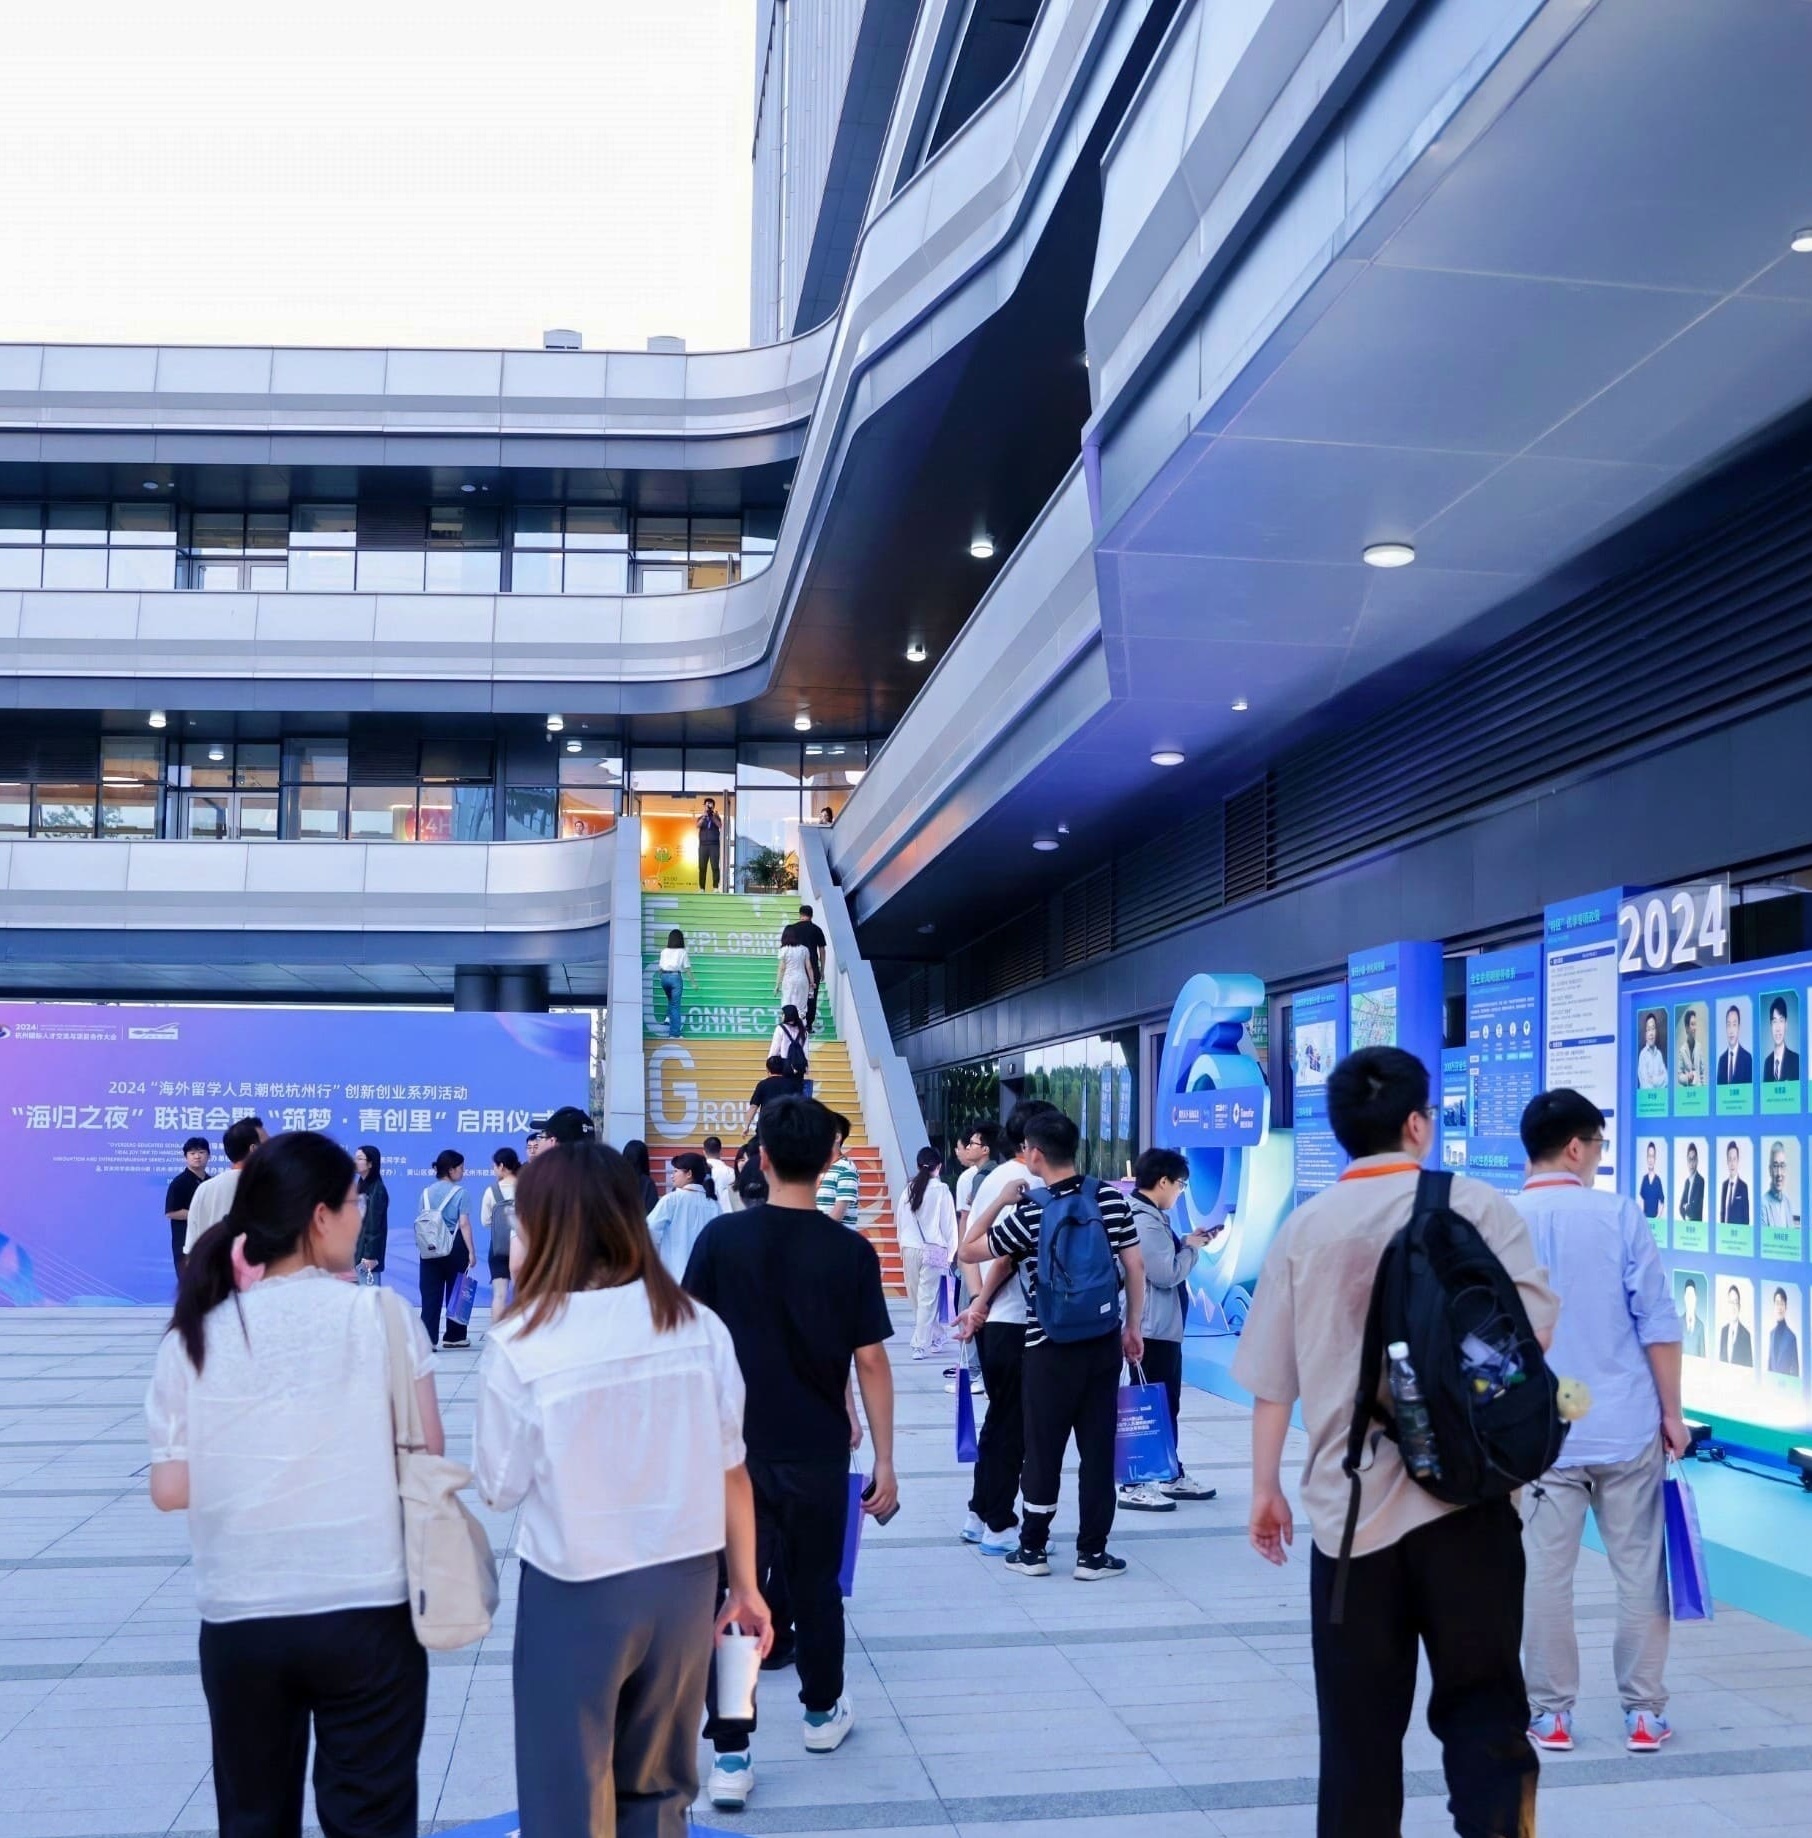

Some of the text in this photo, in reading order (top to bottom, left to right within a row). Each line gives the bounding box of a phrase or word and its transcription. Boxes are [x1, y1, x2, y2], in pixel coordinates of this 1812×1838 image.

[1617, 883, 1727, 974] 2024
[15, 1023, 37, 1031] 2024
[108, 1080, 468, 1100] 2024 “海外留学人员潮悦杭州行” 创新创业系列活动
[12, 1104, 143, 1130] “海归之夜”
